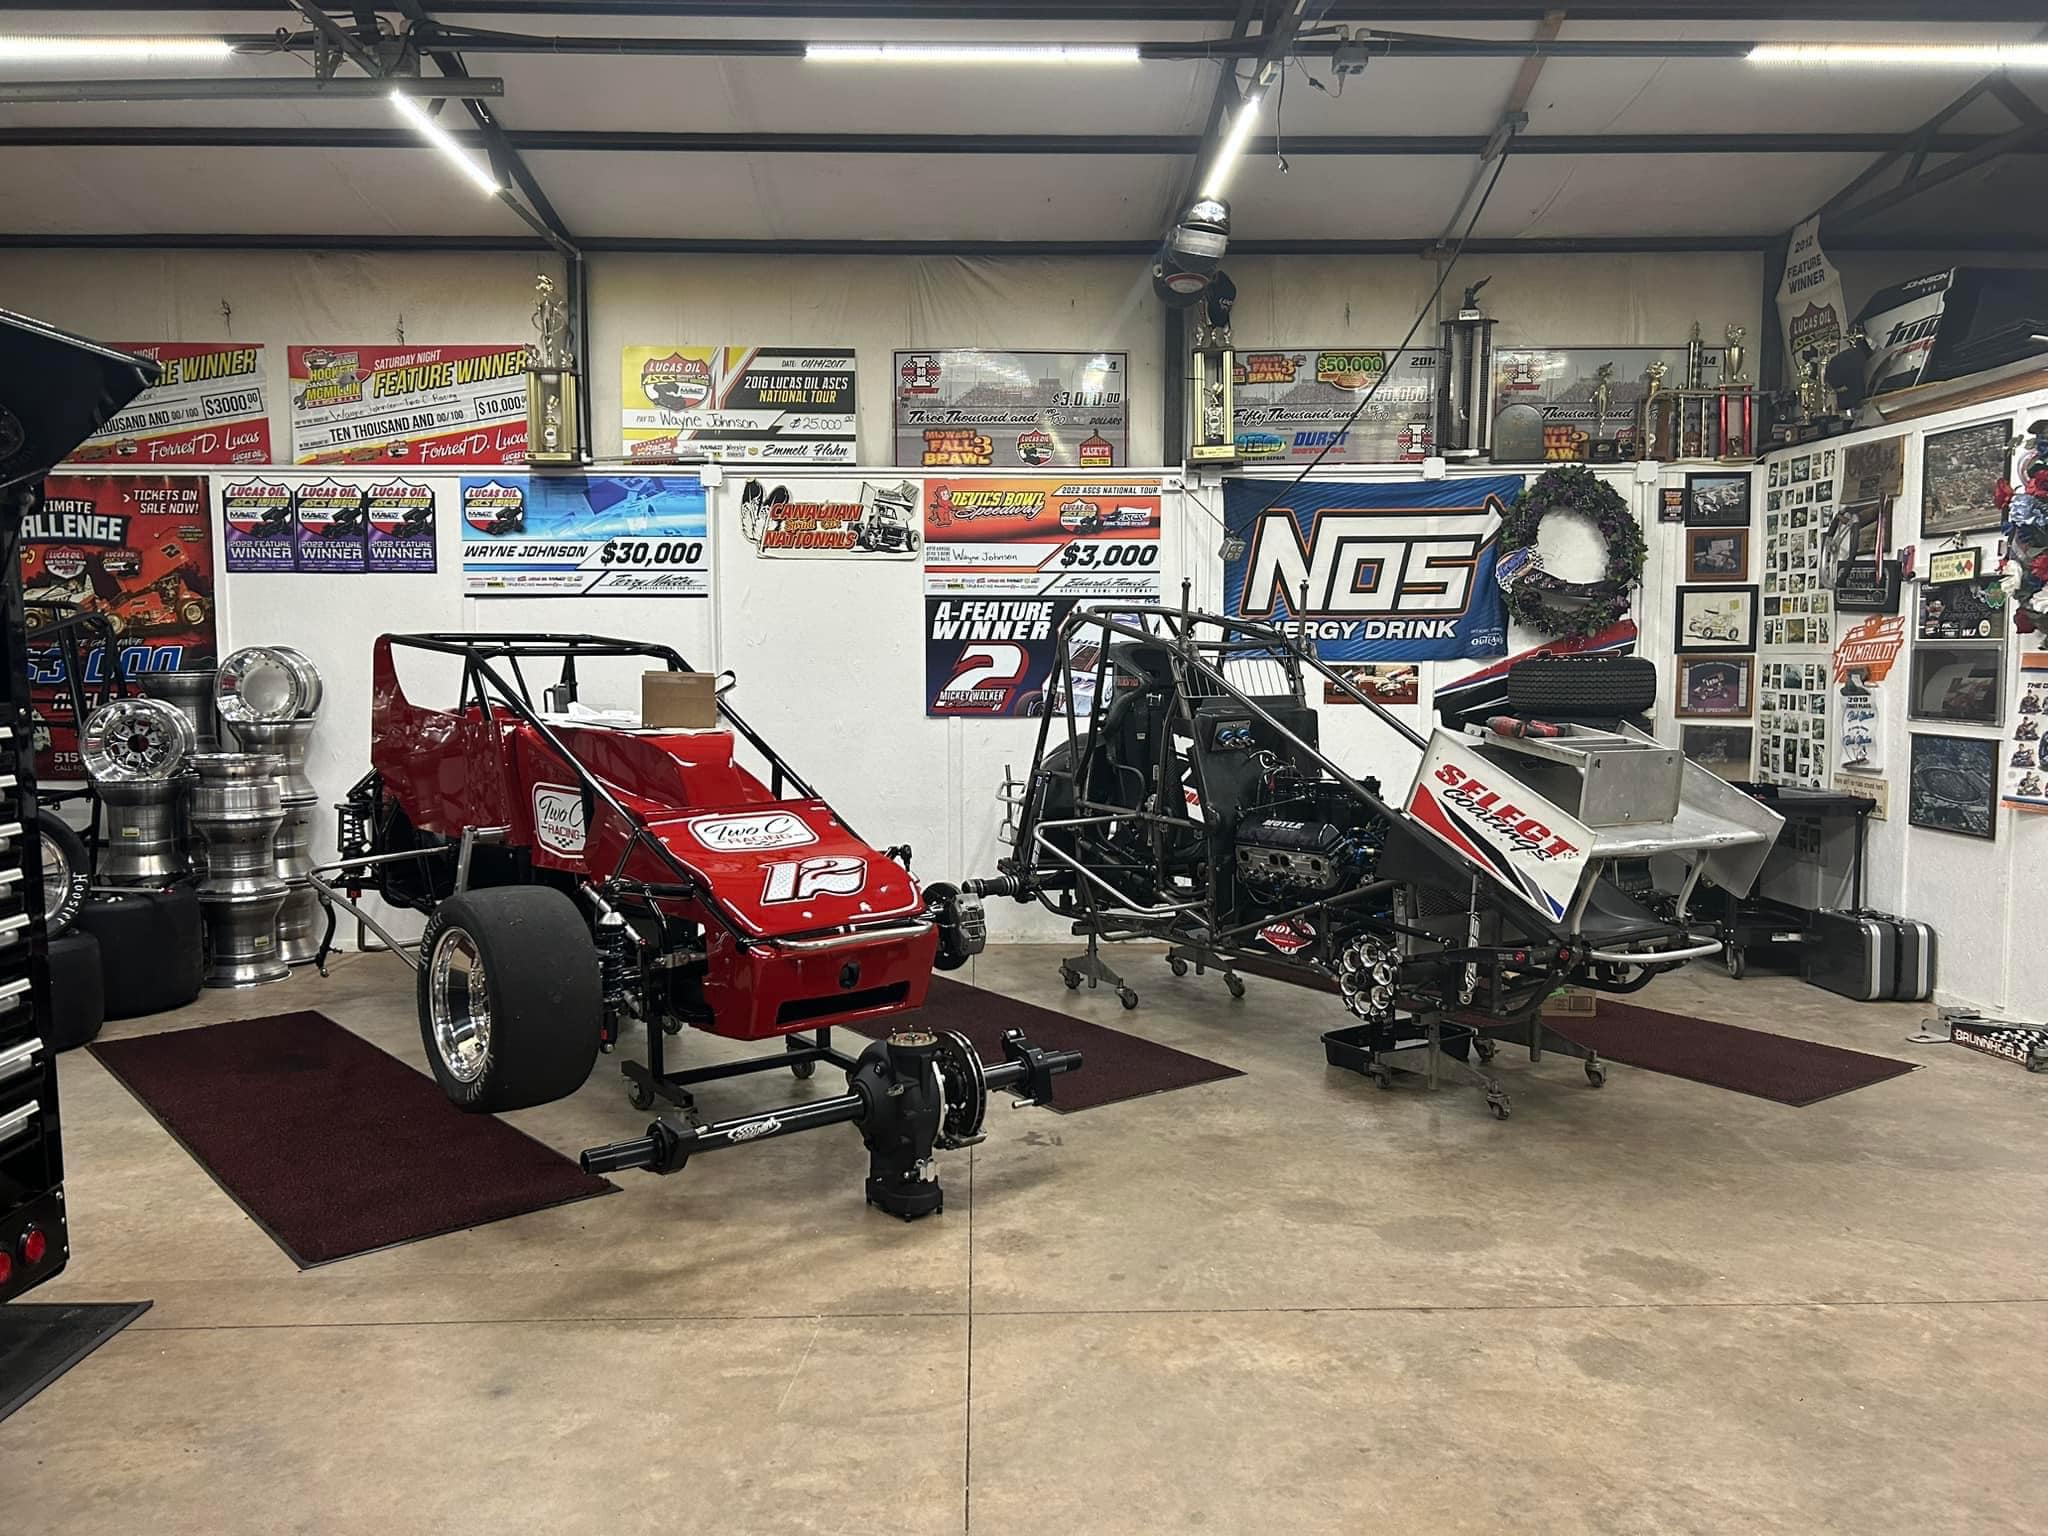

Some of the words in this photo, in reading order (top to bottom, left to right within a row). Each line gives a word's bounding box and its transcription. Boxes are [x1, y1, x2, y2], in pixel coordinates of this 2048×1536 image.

[1787, 254, 1822, 279] FEATURE
[1788, 269, 1825, 295] WINNER
[1794, 314, 1818, 335] LUCAS
[1819, 310, 1831, 325] OIL
[182, 349, 258, 384] WINNER
[374, 353, 416, 372] SATURDAY
[415, 349, 442, 365] NIGHT
[649, 361, 683, 373] LUCAS
[684, 361, 701, 373] OIL
[1251, 362, 1282, 373] FALL
[373, 361, 455, 399] FEATURE
[455, 350, 528, 384] WINNER
[744, 375, 769, 389] 2016
[770, 375, 803, 389] LUCAS
[804, 375, 820, 389] OIL
[822, 376, 849, 390] ASCS
[759, 389, 808, 403] NATIONAL
[811, 389, 837, 403] TOUR
[149, 410, 170, 427] AND
[659, 409, 702, 433] Wayne
[705, 412, 760, 430] Johnson
[908, 410, 944, 424] Three
[944, 410, 1008, 424] Thousand
[1009, 411, 1038, 424] and
[1267, 407, 1330, 421] Thousand
[1609, 407, 1634, 419] and
[329, 427, 351, 443] TEN
[354, 417, 411, 440] THOUSAND
[412, 412, 435, 430] AND
[436, 409, 464, 423] 00/100
[225, 428, 261, 451] Lucas
[929, 439, 974, 451] FALL
[974, 435, 993, 455] 3
[923, 452, 992, 465] BRAWL
[133, 489, 180, 501] TICKETS
[182, 489, 198, 501] ON
[230, 487, 267, 497] LUCAS
[268, 487, 286, 497] OIL
[301, 487, 338, 497] LUCAS
[339, 488, 357, 498] OIL
[372, 487, 408, 497] LUCAS
[409, 487, 427, 497] OIL
[468, 489, 501, 498] LUCAS
[502, 489, 518, 498] OIL
[1002, 491, 1045, 506] BOWL
[1061, 486, 1081, 494] 2022
[1081, 486, 1101, 495] ASCS
[1102, 486, 1137, 495] NATIONAL
[1140, 486, 1158, 495] TOUR
[139, 503, 167, 514] SALE
[168, 503, 199, 514] NOW!
[769, 503, 864, 522] CANADIAN
[954, 503, 1045, 520] Speedway
[20, 513, 123, 541] ALLENGE
[763, 530, 858, 549] NATIONALS
[230, 548, 292, 559] WINNER
[301, 548, 362, 559] WINNER
[371, 548, 433, 559] WINNER
[464, 545, 517, 558] WAYNE
[518, 545, 588, 558] JOHNSON
[600, 541, 703, 568] $30,000
[952, 548, 980, 564] Wayne
[981, 551, 1018, 562] Johnson
[1060, 542, 1159, 570] $3,000
[1244, 502, 1502, 611] NOS
[934, 601, 1055, 621] A-FEATURE
[932, 621, 1052, 640] WINNER
[1364, 619, 1460, 640] DRINK
[942, 643, 1023, 691] 2
[538, 795, 566, 825] Two
[1434, 763, 1580, 857] SELECT
[547, 823, 580, 841] RACING
[703, 821, 760, 841] Two
[763, 816, 794, 834] C
[1442, 788, 1553, 862] Coatings
[762, 855, 868, 906] 12
